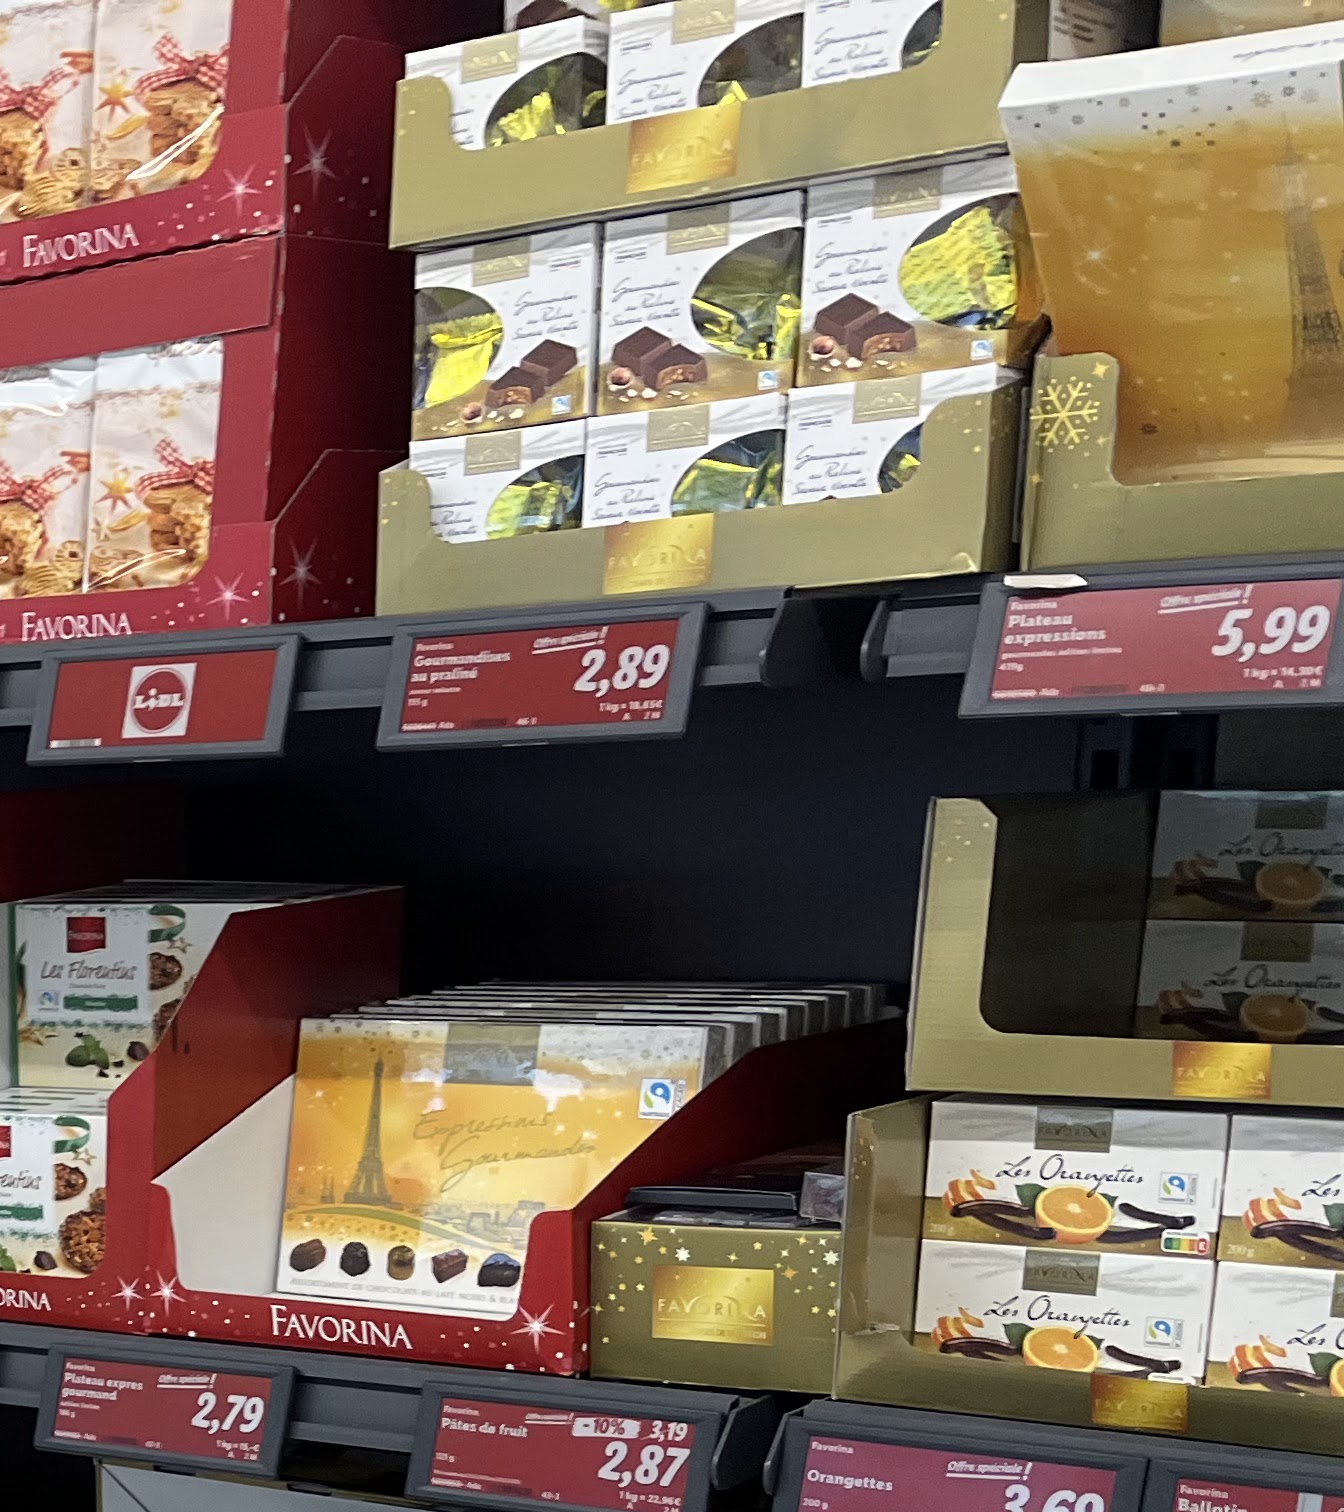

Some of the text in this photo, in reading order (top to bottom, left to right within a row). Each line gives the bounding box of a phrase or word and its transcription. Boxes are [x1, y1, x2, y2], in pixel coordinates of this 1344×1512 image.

[21, 222, 140, 269] FAVORINA
[21, 611, 133, 643] FAVORINA
[1007, 614, 1073, 629] Plateau
[1212, 605, 1331, 663] 5,99
[1003, 627, 1107, 646] expressions
[573, 644, 670, 698] 2,89
[134, 689, 186, 713] LIDL
[40, 959, 138, 982] Les Florentins
[995, 1153, 1144, 1198] Les Orangettes
[1301, 1172, 1341, 1198] Les
[269, 1304, 413, 1350] FAVORINA
[983, 1294, 1130, 1339] Les Orangettes
[1286, 1323, 1327, 1347] Les
[191, 1392, 264, 1435] 2,79
[441, 1417, 529, 1438] Pâtes de fruit
[648, 1419, 689, 1443] 3,19
[597, 1441, 691, 1488] 2,87
[806, 1469, 893, 1492] Orangettes
[1179, 1484, 1229, 1499] Favorina
